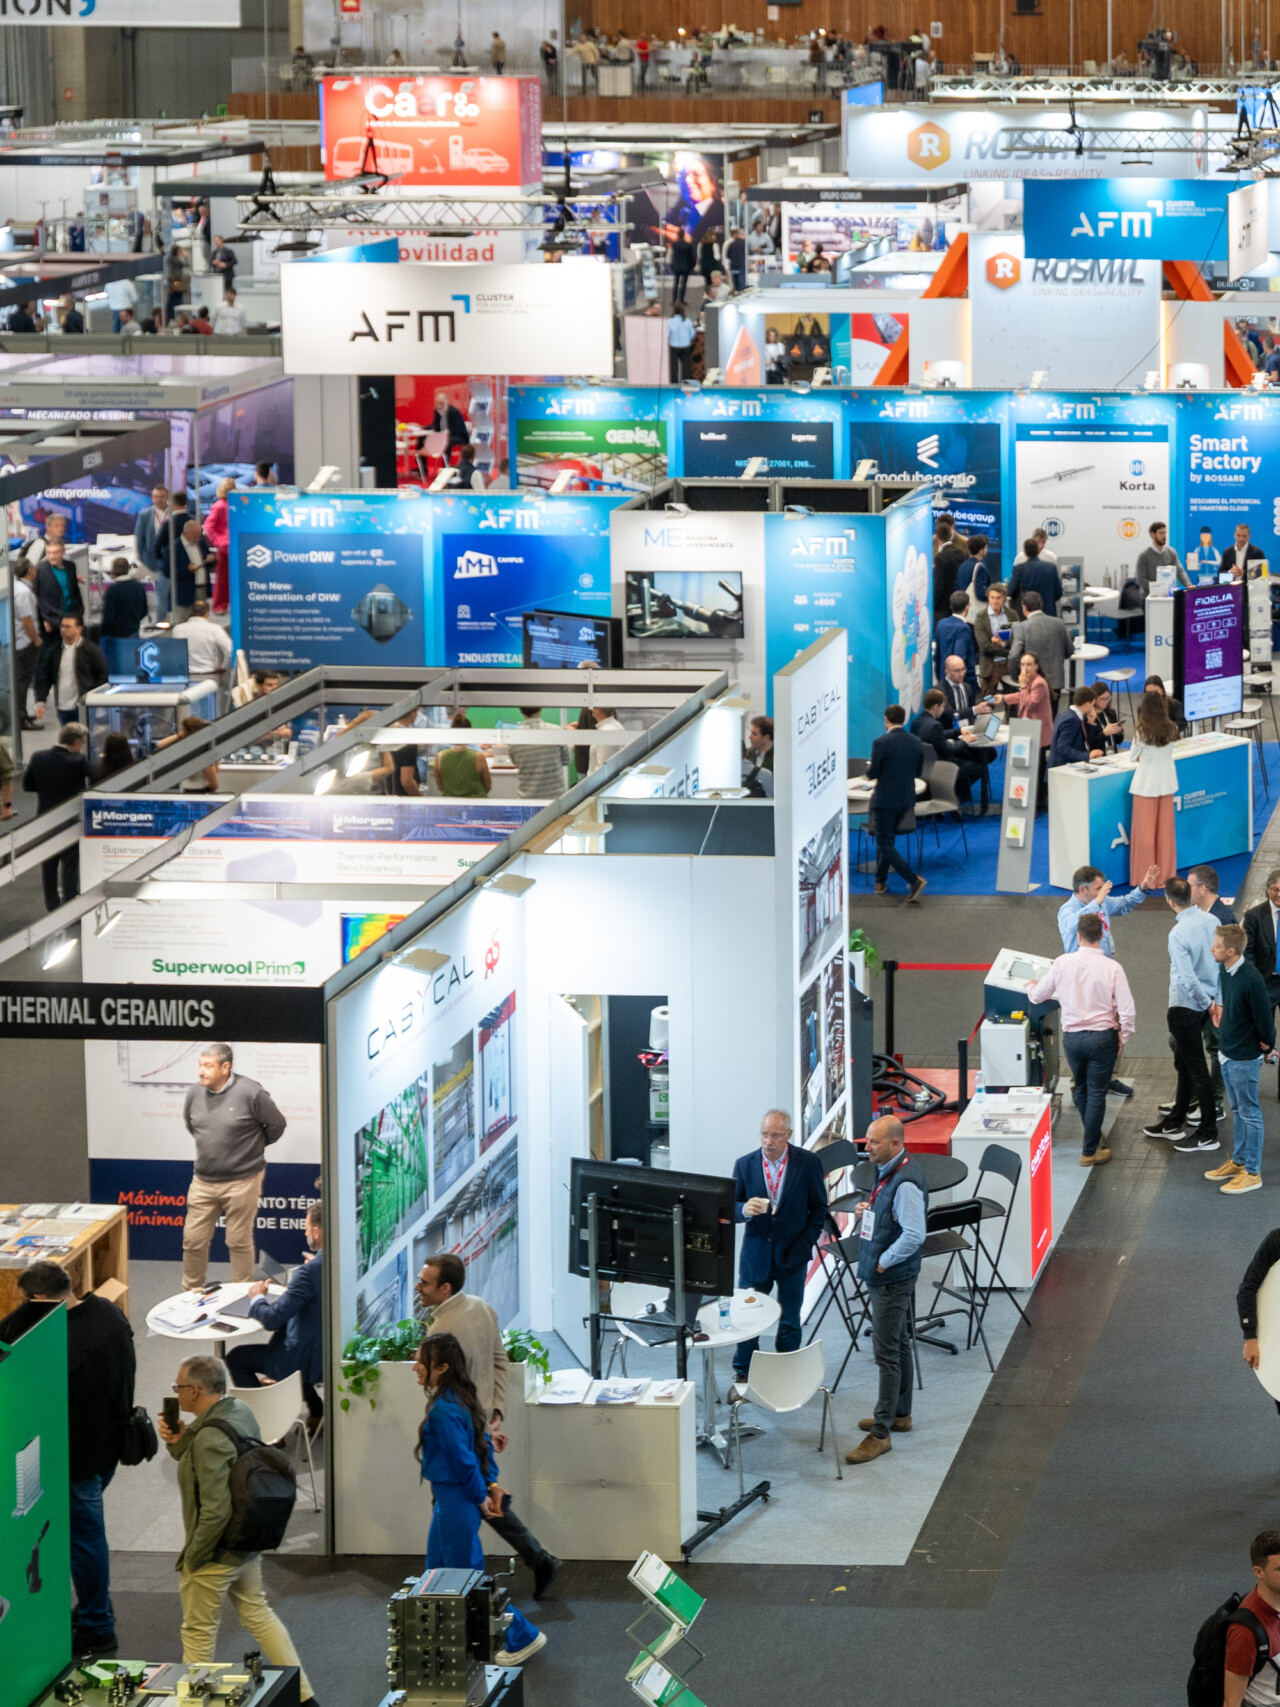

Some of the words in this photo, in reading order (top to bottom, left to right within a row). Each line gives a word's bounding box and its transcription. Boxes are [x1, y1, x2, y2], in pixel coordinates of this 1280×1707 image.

[963, 168, 1009, 178] LINKING
[820, 192, 841, 200] GRUPO
[1071, 212, 1153, 237] AFM
[399, 244, 495, 261] ovilidad
[1032, 258, 1145, 285] ROSMIL
[1033, 288, 1068, 296] LINKING
[350, 311, 456, 342] AFM
[546, 399, 596, 416] AFM
[712, 400, 762, 416] AFM
[879, 401, 929, 418] AFM
[1046, 402, 1096, 419] AFM
[1214, 404, 1264, 420] AFM
[28, 411, 91, 420] MECANIZADO
[93, 411, 104, 420] EN
[107, 411, 135, 420] SERIE
[1190, 434, 1248, 451] Smart
[769, 460, 792, 469] 27001,
[1190, 453, 1262, 474] Factory
[1190, 473, 1202, 484] by
[1205, 474, 1245, 482] BOSSARD
[1119, 482, 1155, 491] Korta
[44, 488, 111, 500] compromiso.
[274, 507, 335, 529] AFM
[479, 509, 540, 530] AFM
[645, 529, 682, 547] ME
[790, 536, 848, 555] AFM
[274, 550, 336, 563] PowerDIW
[497, 557, 524, 565] CAMPUS
[248, 582, 268, 591] The
[270, 582, 291, 591] New
[248, 592, 304, 602] Generation
[306, 592, 316, 601] of
[318, 592, 341, 602] DIW
[814, 598, 835, 606] +800
[1195, 592, 1233, 606] FIDELIA
[458, 653, 523, 663] INDUSTRIAL
[798, 685, 841, 736] CABYCAL
[103, 811, 152, 823] Morgan
[342, 815, 394, 827] Morgan
[188, 847, 222, 856] Blanket
[337, 851, 373, 862] Thermal
[337, 863, 402, 874] Benchmarking
[153, 958, 252, 976] Superwool
[0, 996, 96, 1025] THERMAL
[100, 998, 215, 1027] CERAMICS
[118, 1190, 186, 1205] Máximo
[257, 1217, 276, 1228] DE
